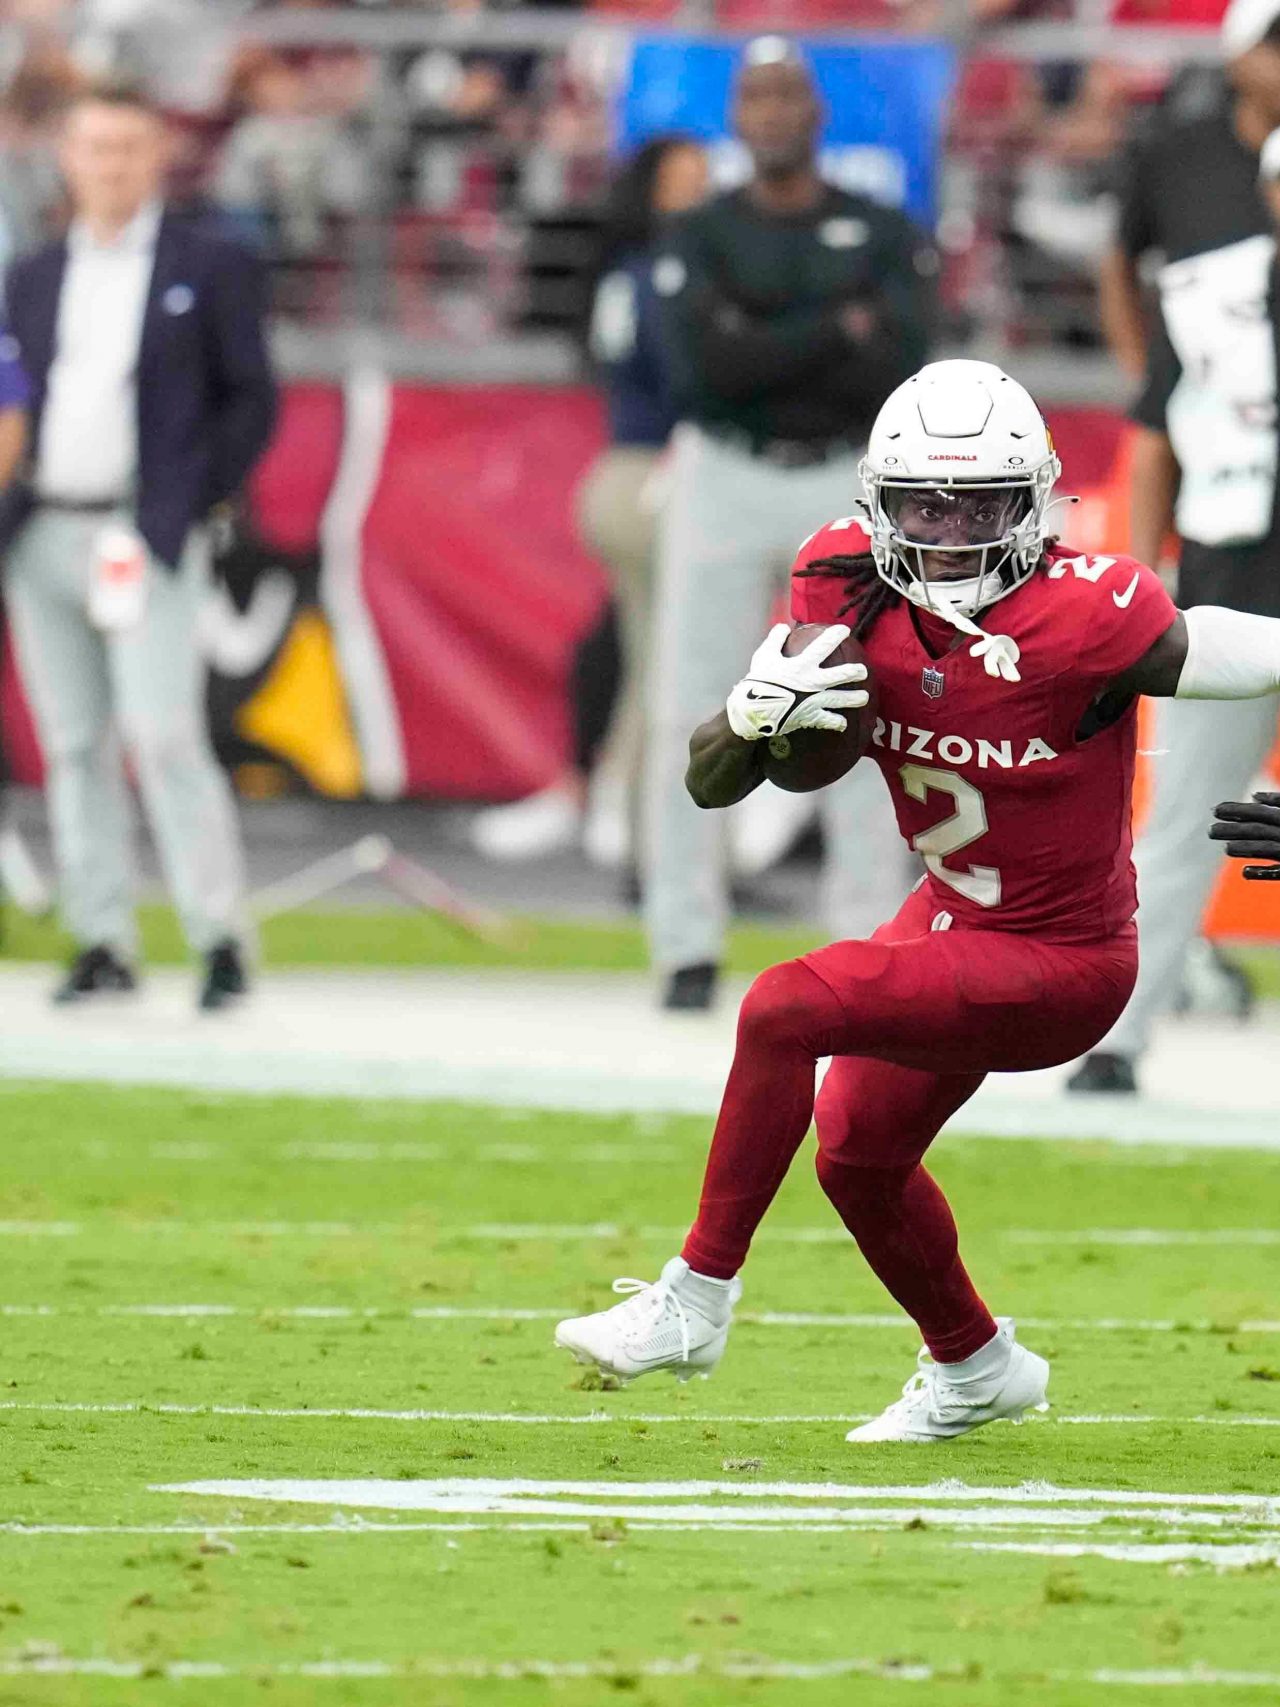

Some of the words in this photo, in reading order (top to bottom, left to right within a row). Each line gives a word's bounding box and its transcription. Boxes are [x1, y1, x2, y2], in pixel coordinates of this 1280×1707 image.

[927, 454, 977, 462] CARDINALS
[1047, 554, 1118, 584] 2
[872, 716, 1059, 769] RIZONA
[898, 762, 1001, 908] 2
